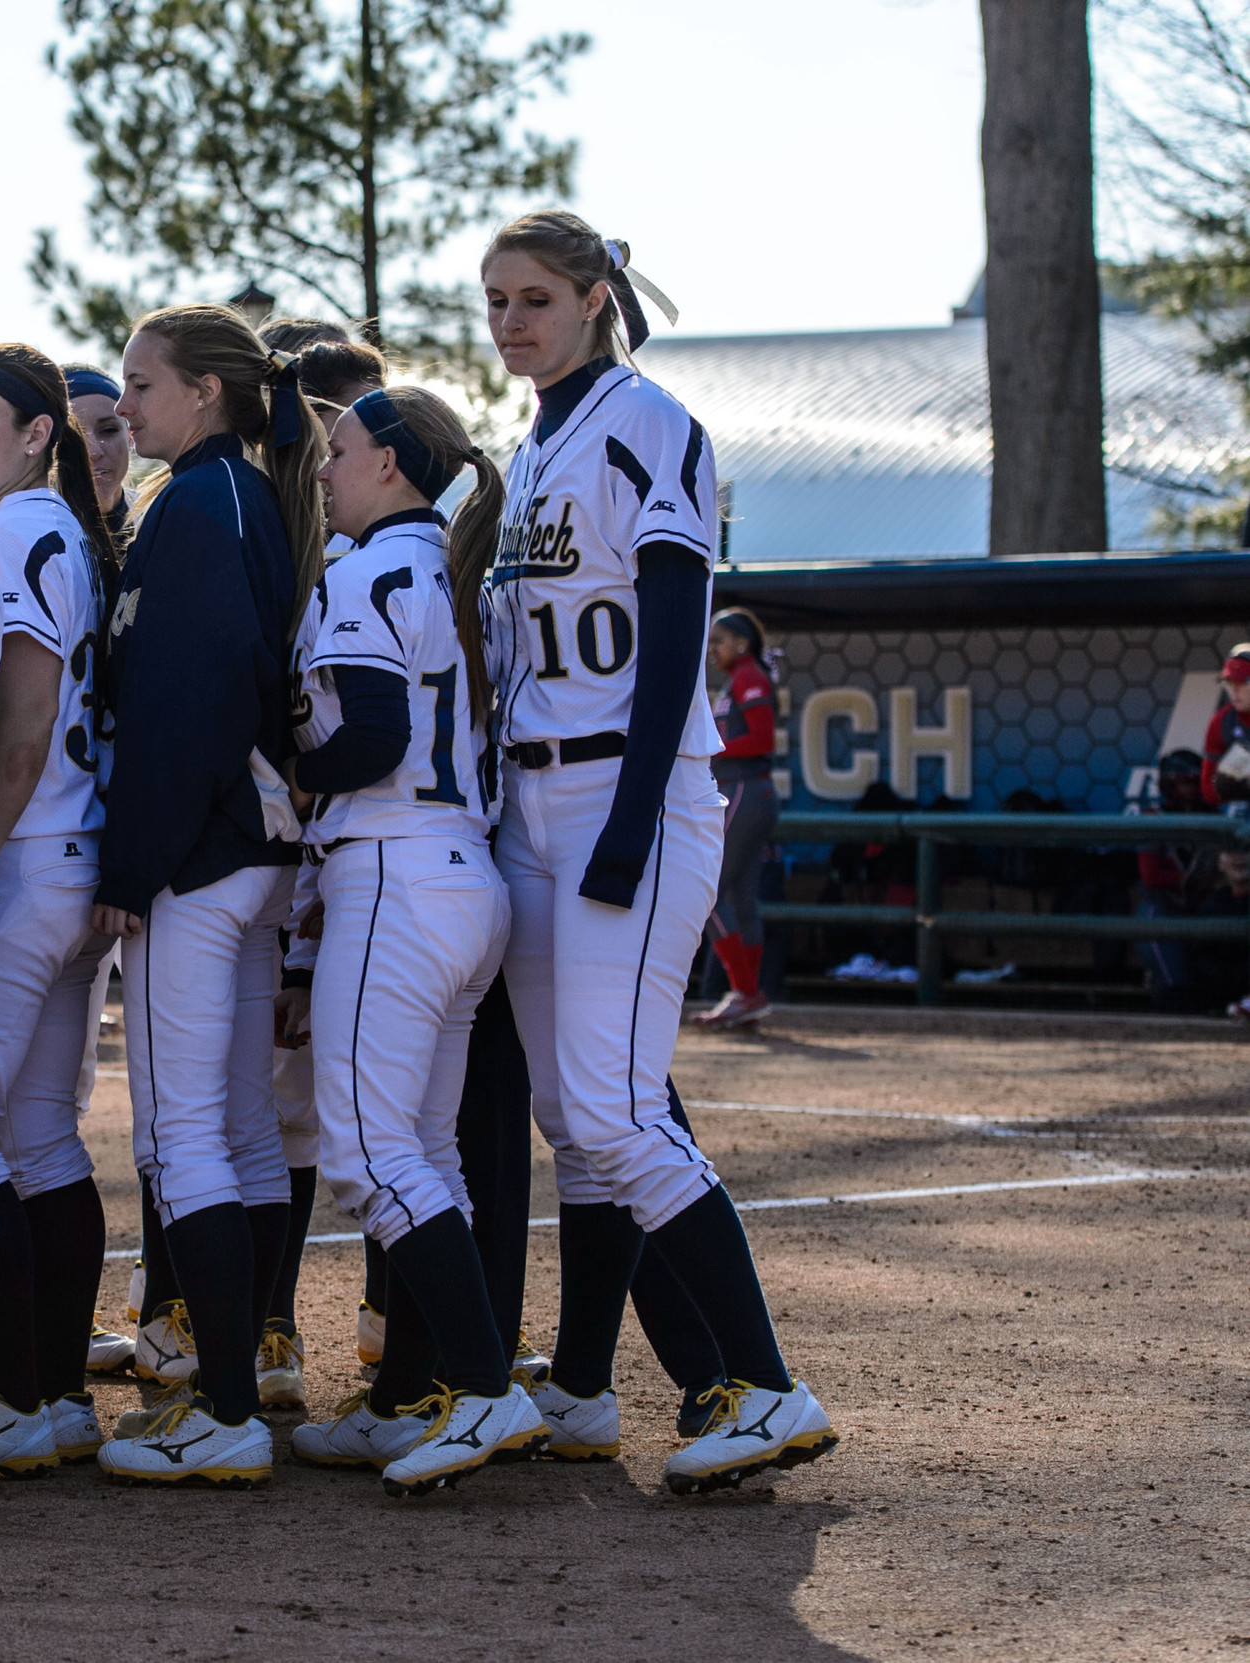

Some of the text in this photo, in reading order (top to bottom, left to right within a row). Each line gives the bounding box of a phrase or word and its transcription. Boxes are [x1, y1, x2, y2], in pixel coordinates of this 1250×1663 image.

[648, 500, 676, 513] ACC
[332, 621, 362, 636] ACC
[527, 599, 634, 681] 10
